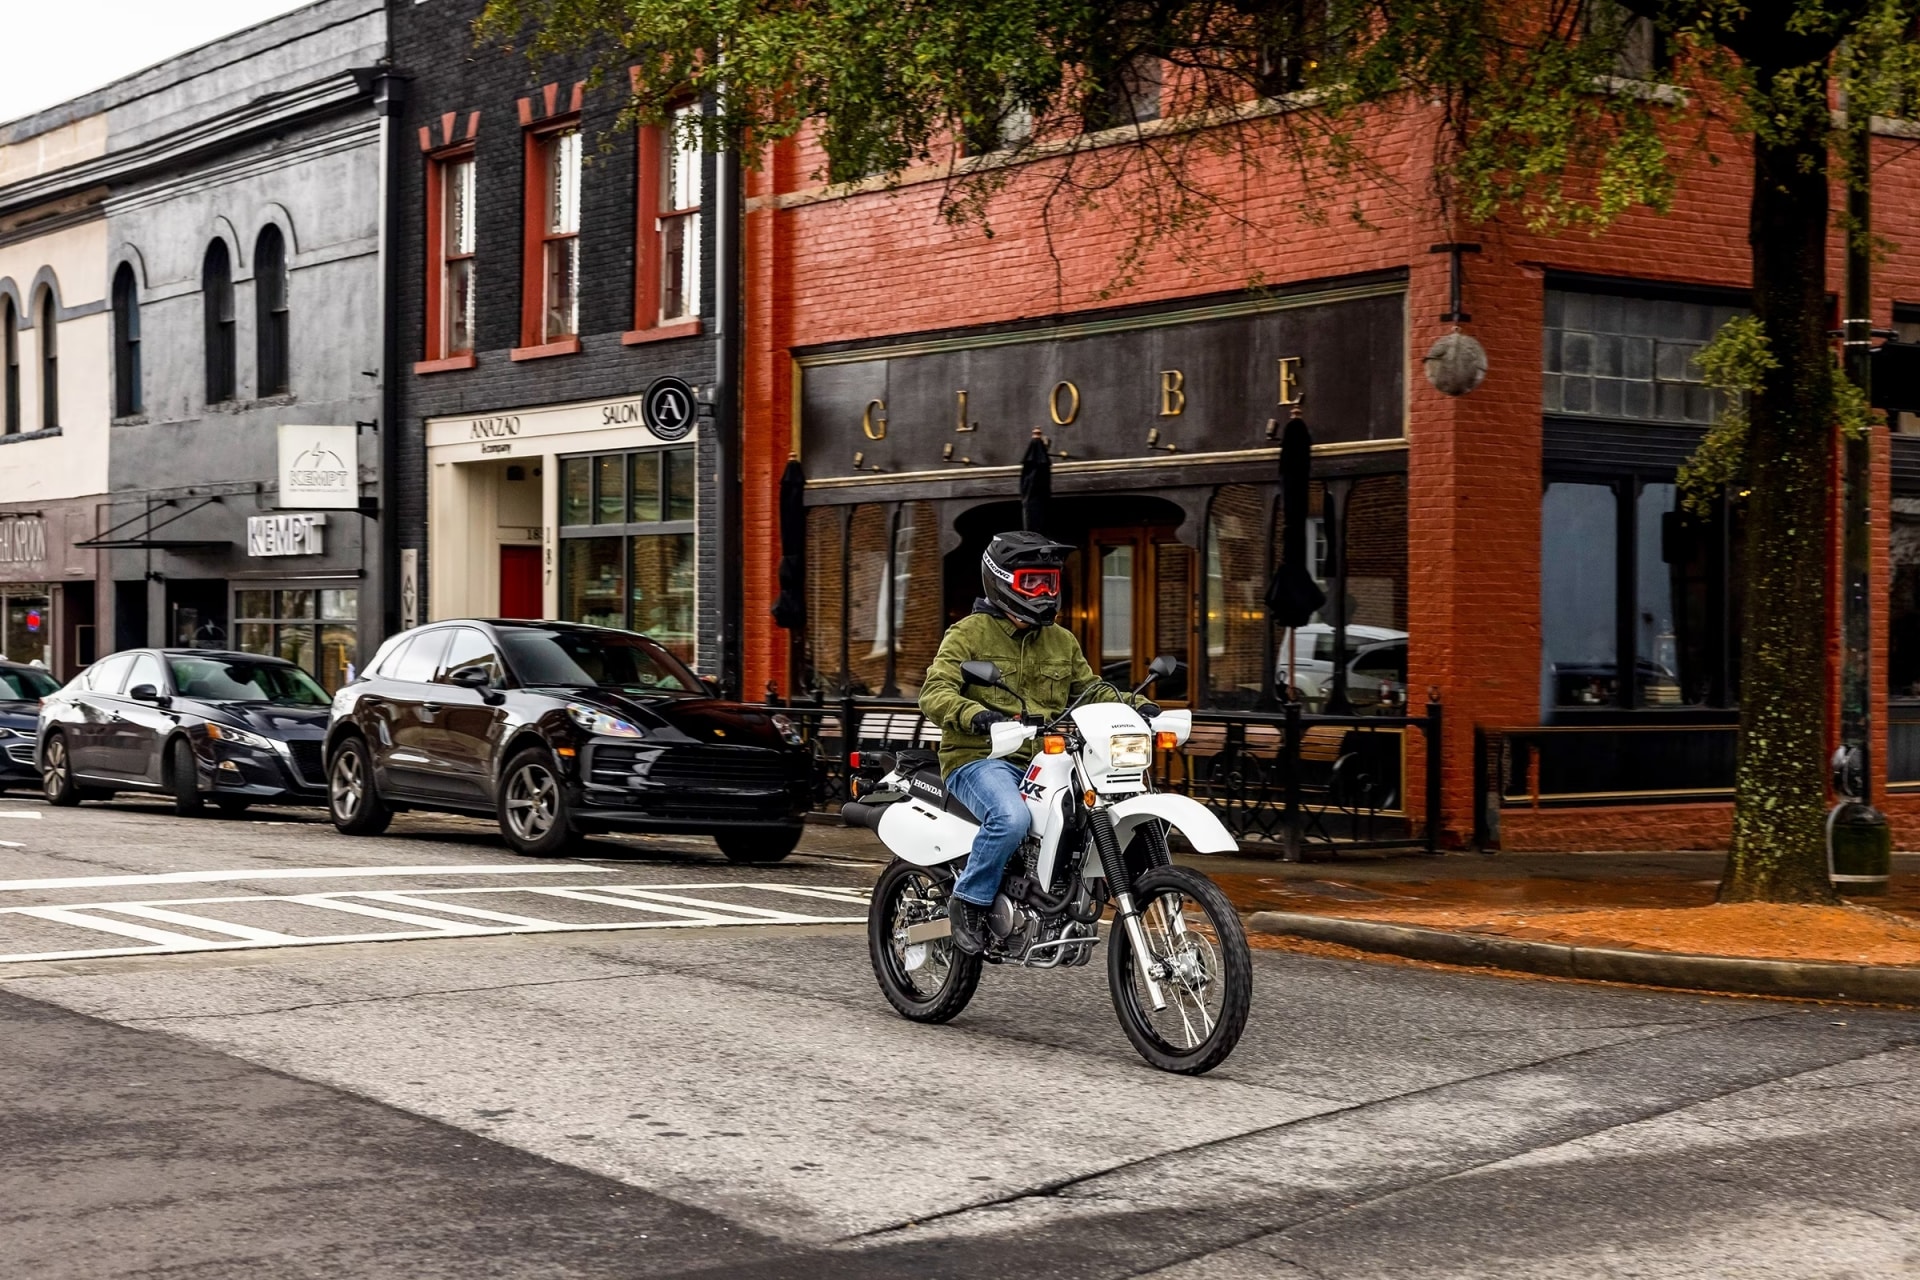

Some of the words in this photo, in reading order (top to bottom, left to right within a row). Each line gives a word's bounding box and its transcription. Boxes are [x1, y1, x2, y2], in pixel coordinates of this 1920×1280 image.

[659, 393, 682, 420] A
[863, 356, 1304, 441] GLOBE
[602, 404, 639, 425] SALON
[470, 416, 521, 439] ANAZAO
[289, 469, 349, 487] KEMPT
[247, 513, 326, 557] KEMPT
[545, 526, 553, 586] 187
[986, 559, 1012, 580] RACING
[913, 778, 943, 798] HONDA
